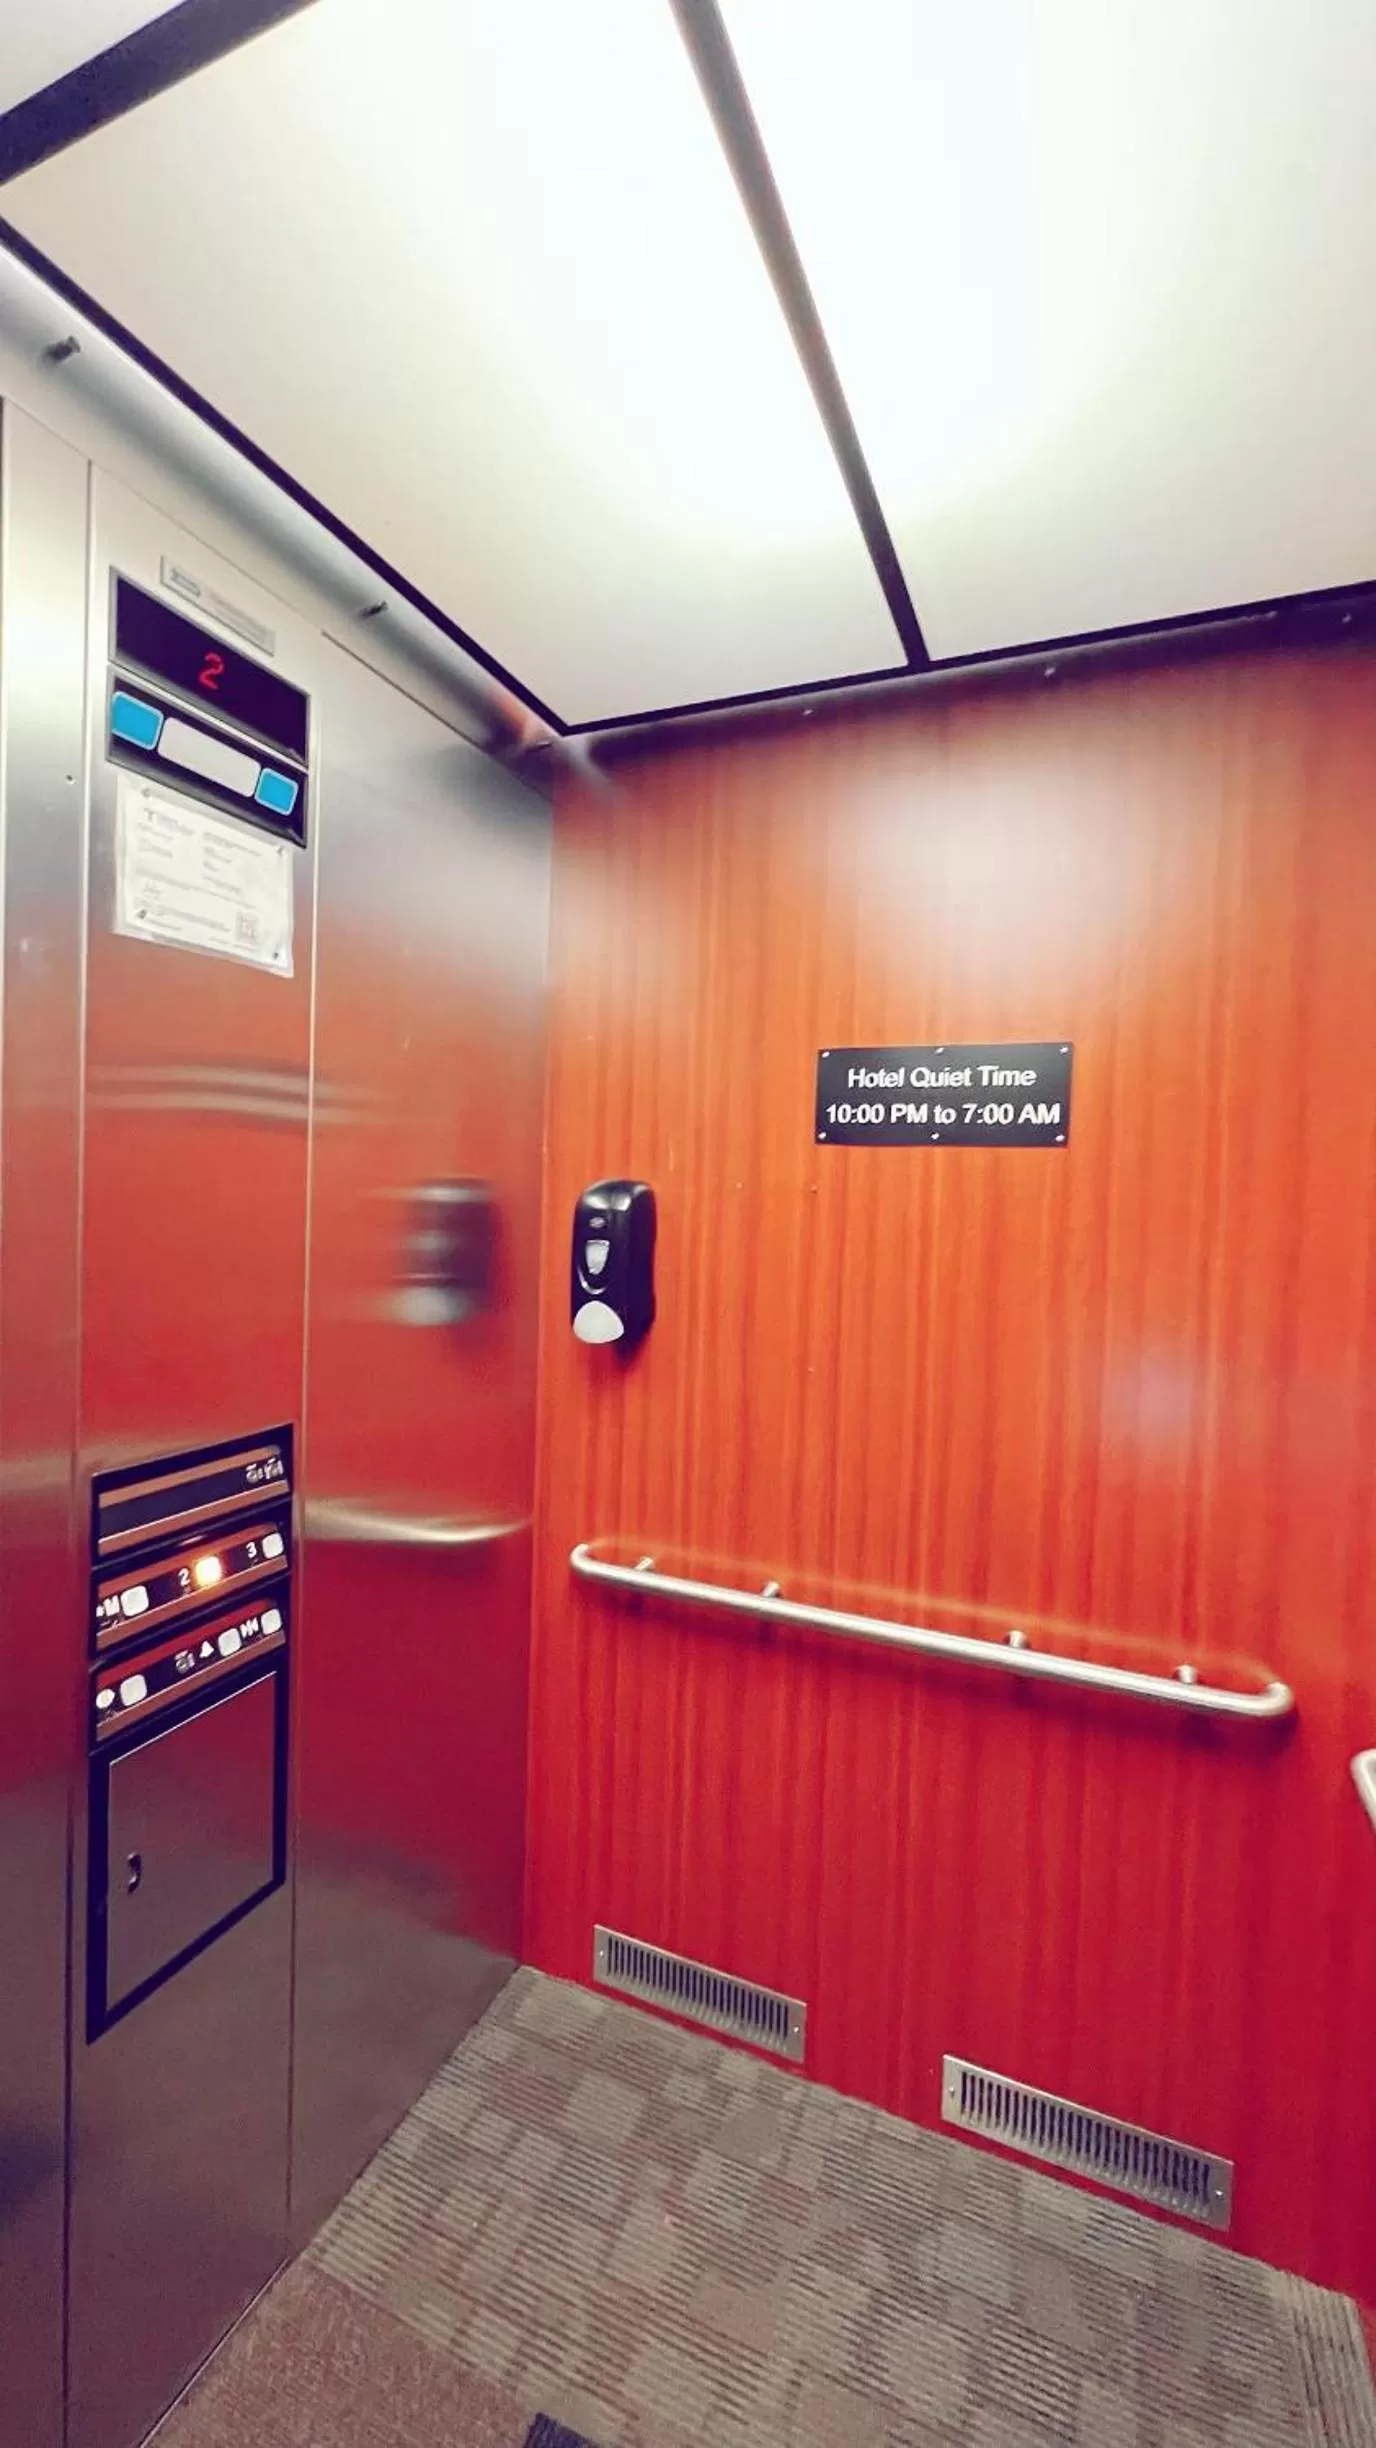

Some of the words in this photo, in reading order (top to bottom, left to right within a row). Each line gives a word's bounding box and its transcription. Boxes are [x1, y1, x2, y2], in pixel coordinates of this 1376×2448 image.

[198, 652, 224, 690] 2
[848, 1066, 905, 1088] Hotel
[910, 1066, 972, 1089] Quiet
[977, 1065, 1037, 1087] Time
[826, 1103, 885, 1124] 10:00
[891, 1103, 928, 1124] PM
[933, 1104, 957, 1124] to
[962, 1103, 1014, 1124] 7:00
[1018, 1102, 1061, 1124] AM
[246, 1542, 257, 1559] 3
[178, 1568, 190, 1587] 2
